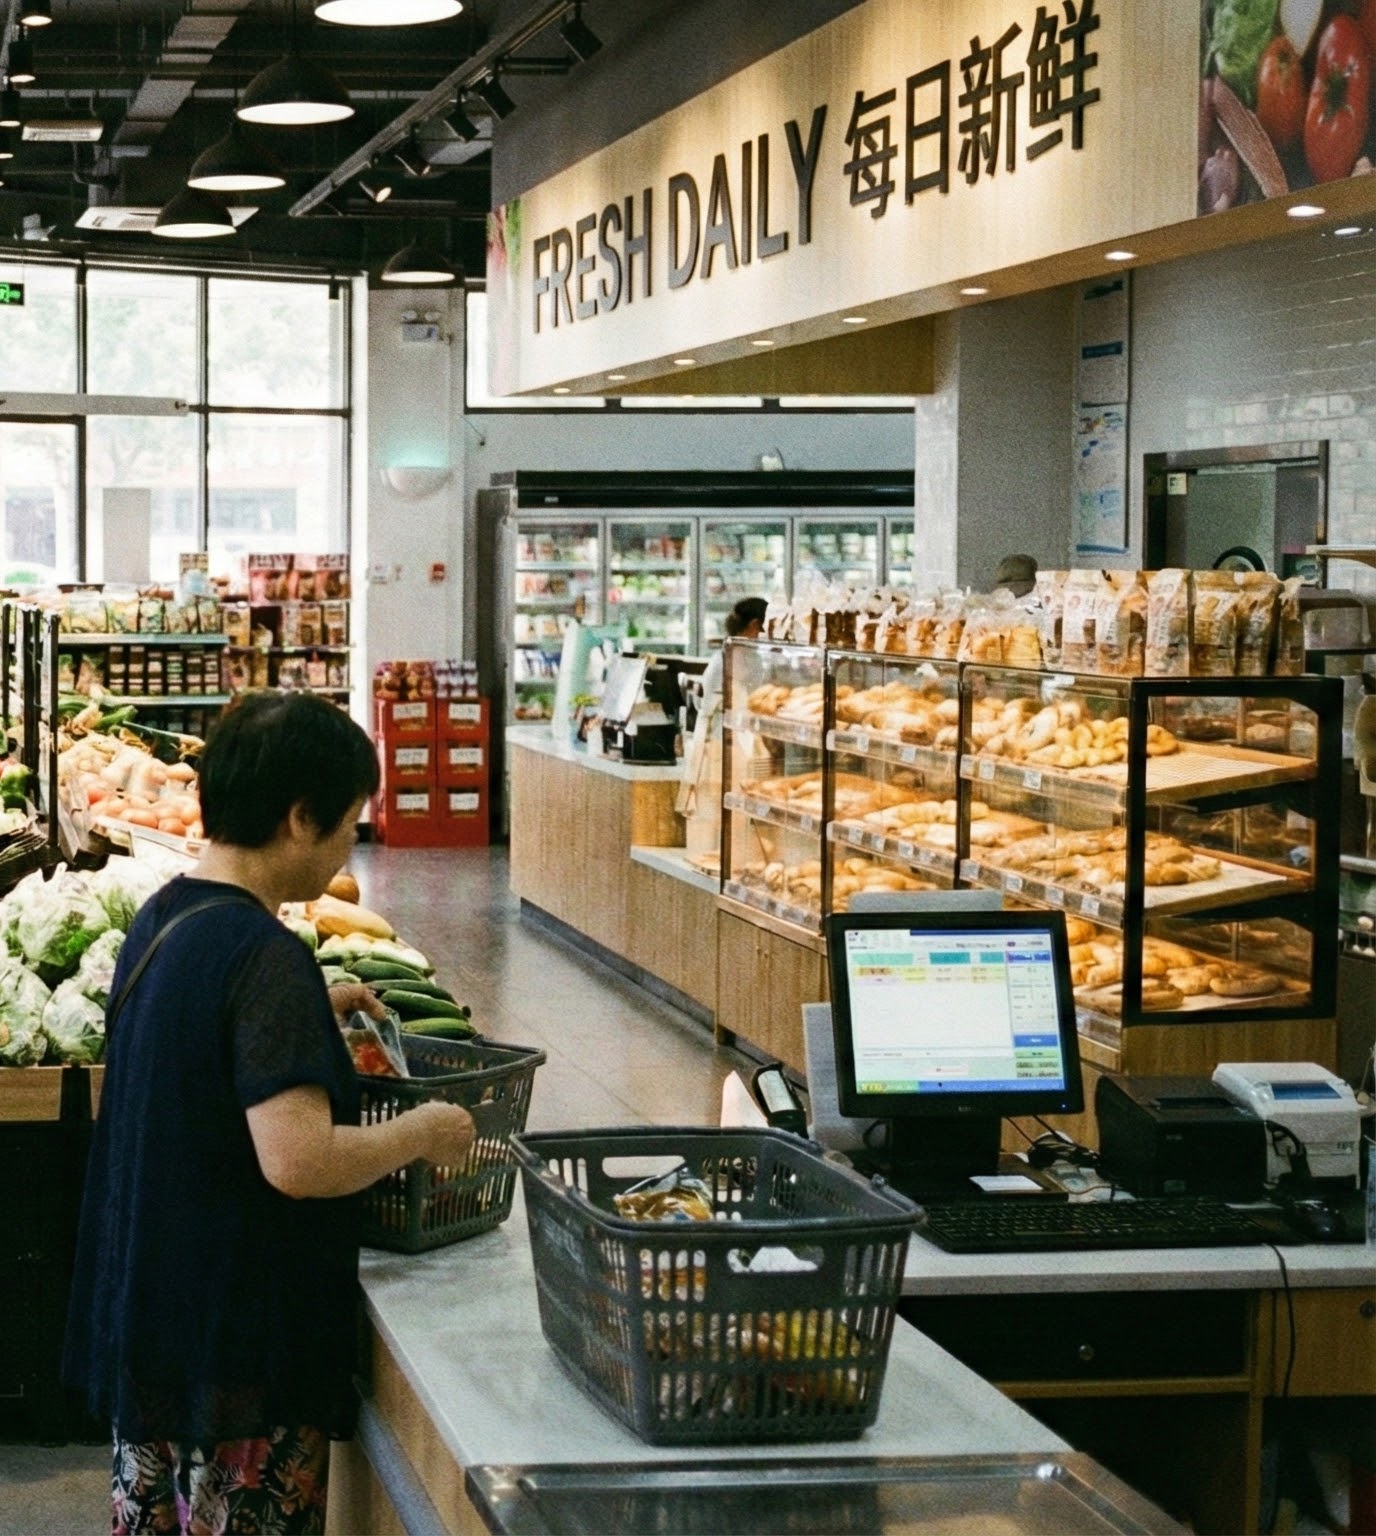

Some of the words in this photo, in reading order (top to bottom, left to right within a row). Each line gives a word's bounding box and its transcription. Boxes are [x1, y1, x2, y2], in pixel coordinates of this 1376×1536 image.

[533, 187, 653, 333] FRESH
[668, 104, 828, 290] DAILY
[843, 0, 1100, 219] 每日新鲜
